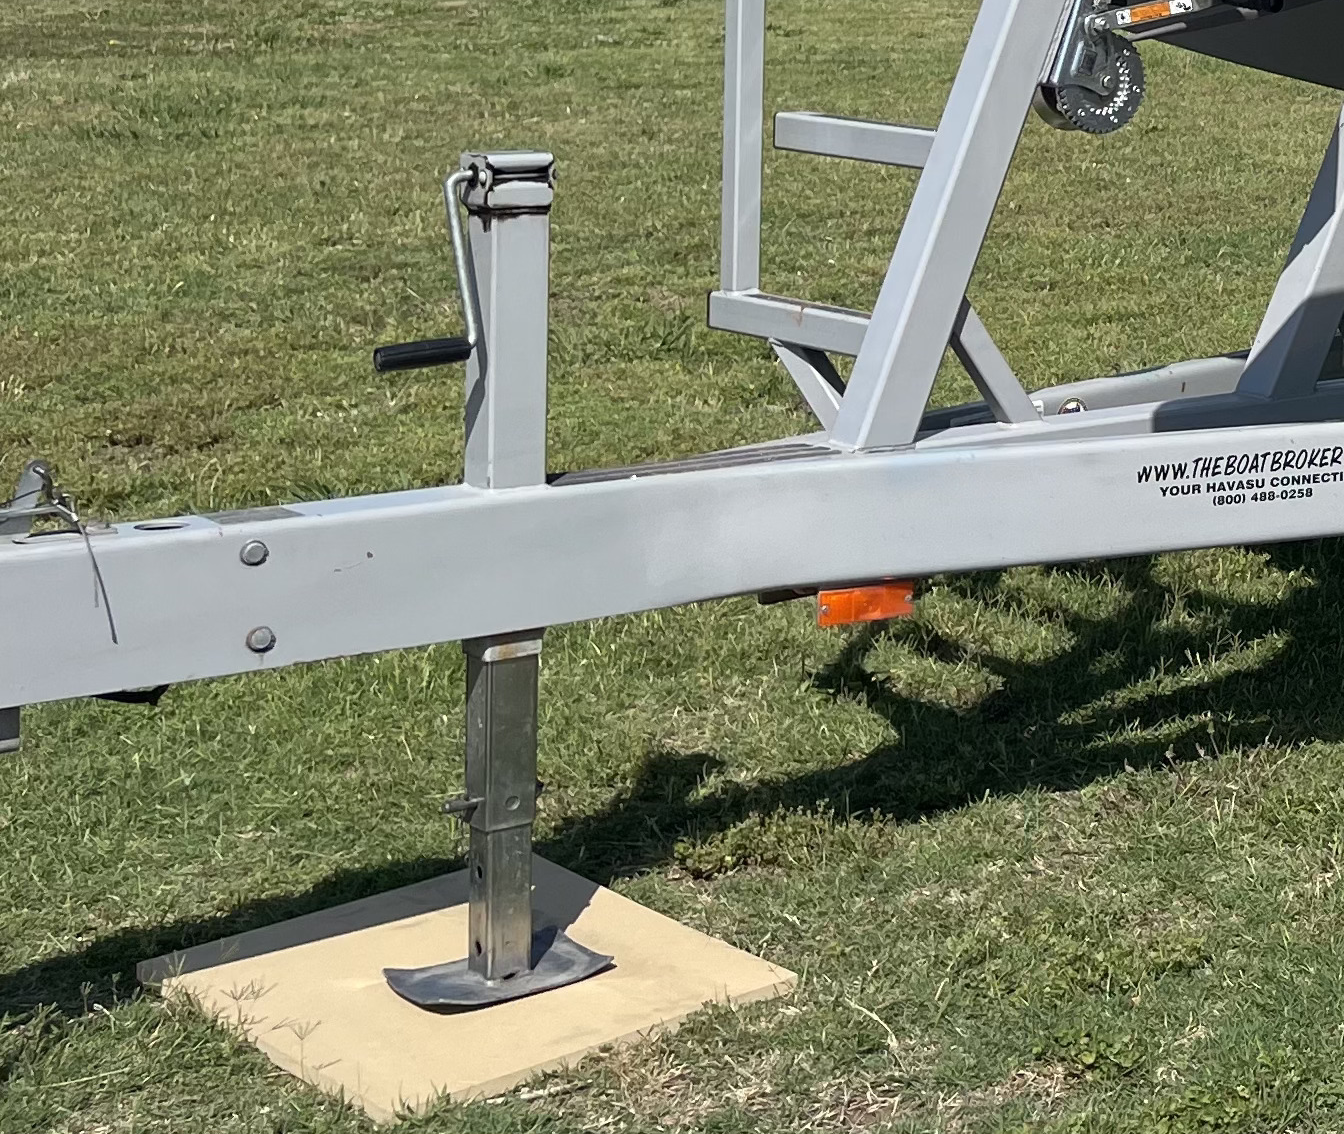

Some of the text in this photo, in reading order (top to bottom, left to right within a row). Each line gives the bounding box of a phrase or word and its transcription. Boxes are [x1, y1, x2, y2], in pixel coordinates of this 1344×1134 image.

[1159, 483, 1202, 497] YOUR
[1206, 478, 1266, 494] HAVASU
[1212, 487, 1313, 507] (800) 488-0258
